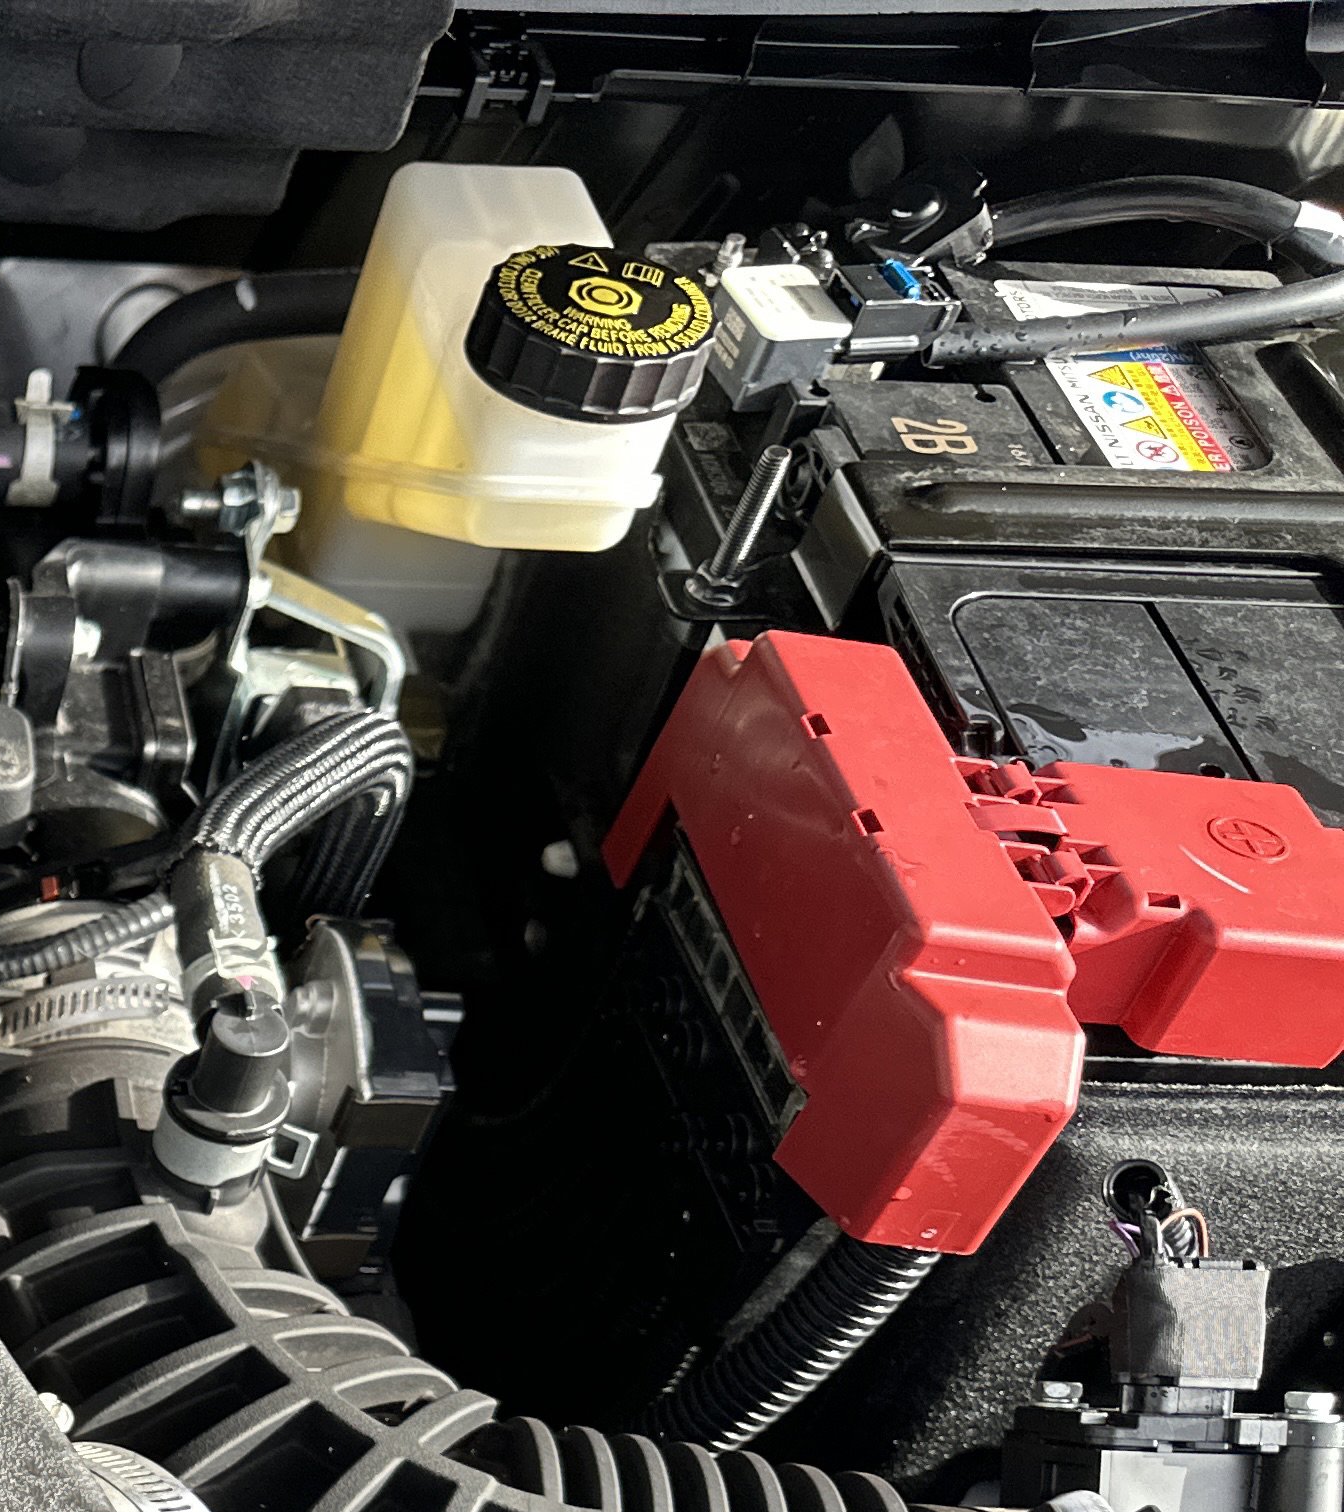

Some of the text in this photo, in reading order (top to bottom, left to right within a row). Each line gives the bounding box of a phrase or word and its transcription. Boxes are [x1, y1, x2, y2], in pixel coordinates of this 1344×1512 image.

[523, 293, 560, 323] FILLER
[557, 318, 589, 335] CAP
[590, 327, 652, 344] BEFORE
[531, 320, 578, 346] BRAKE
[580, 338, 624, 357] FLUID
[626, 341, 669, 357] FROM
[666, 339, 681, 352] A
[674, 319, 711, 348] SEALED
[563, 305, 632, 331] WARNING
[891, 416, 978, 456] 2B
[1078, 392, 1123, 449] NISSAN
